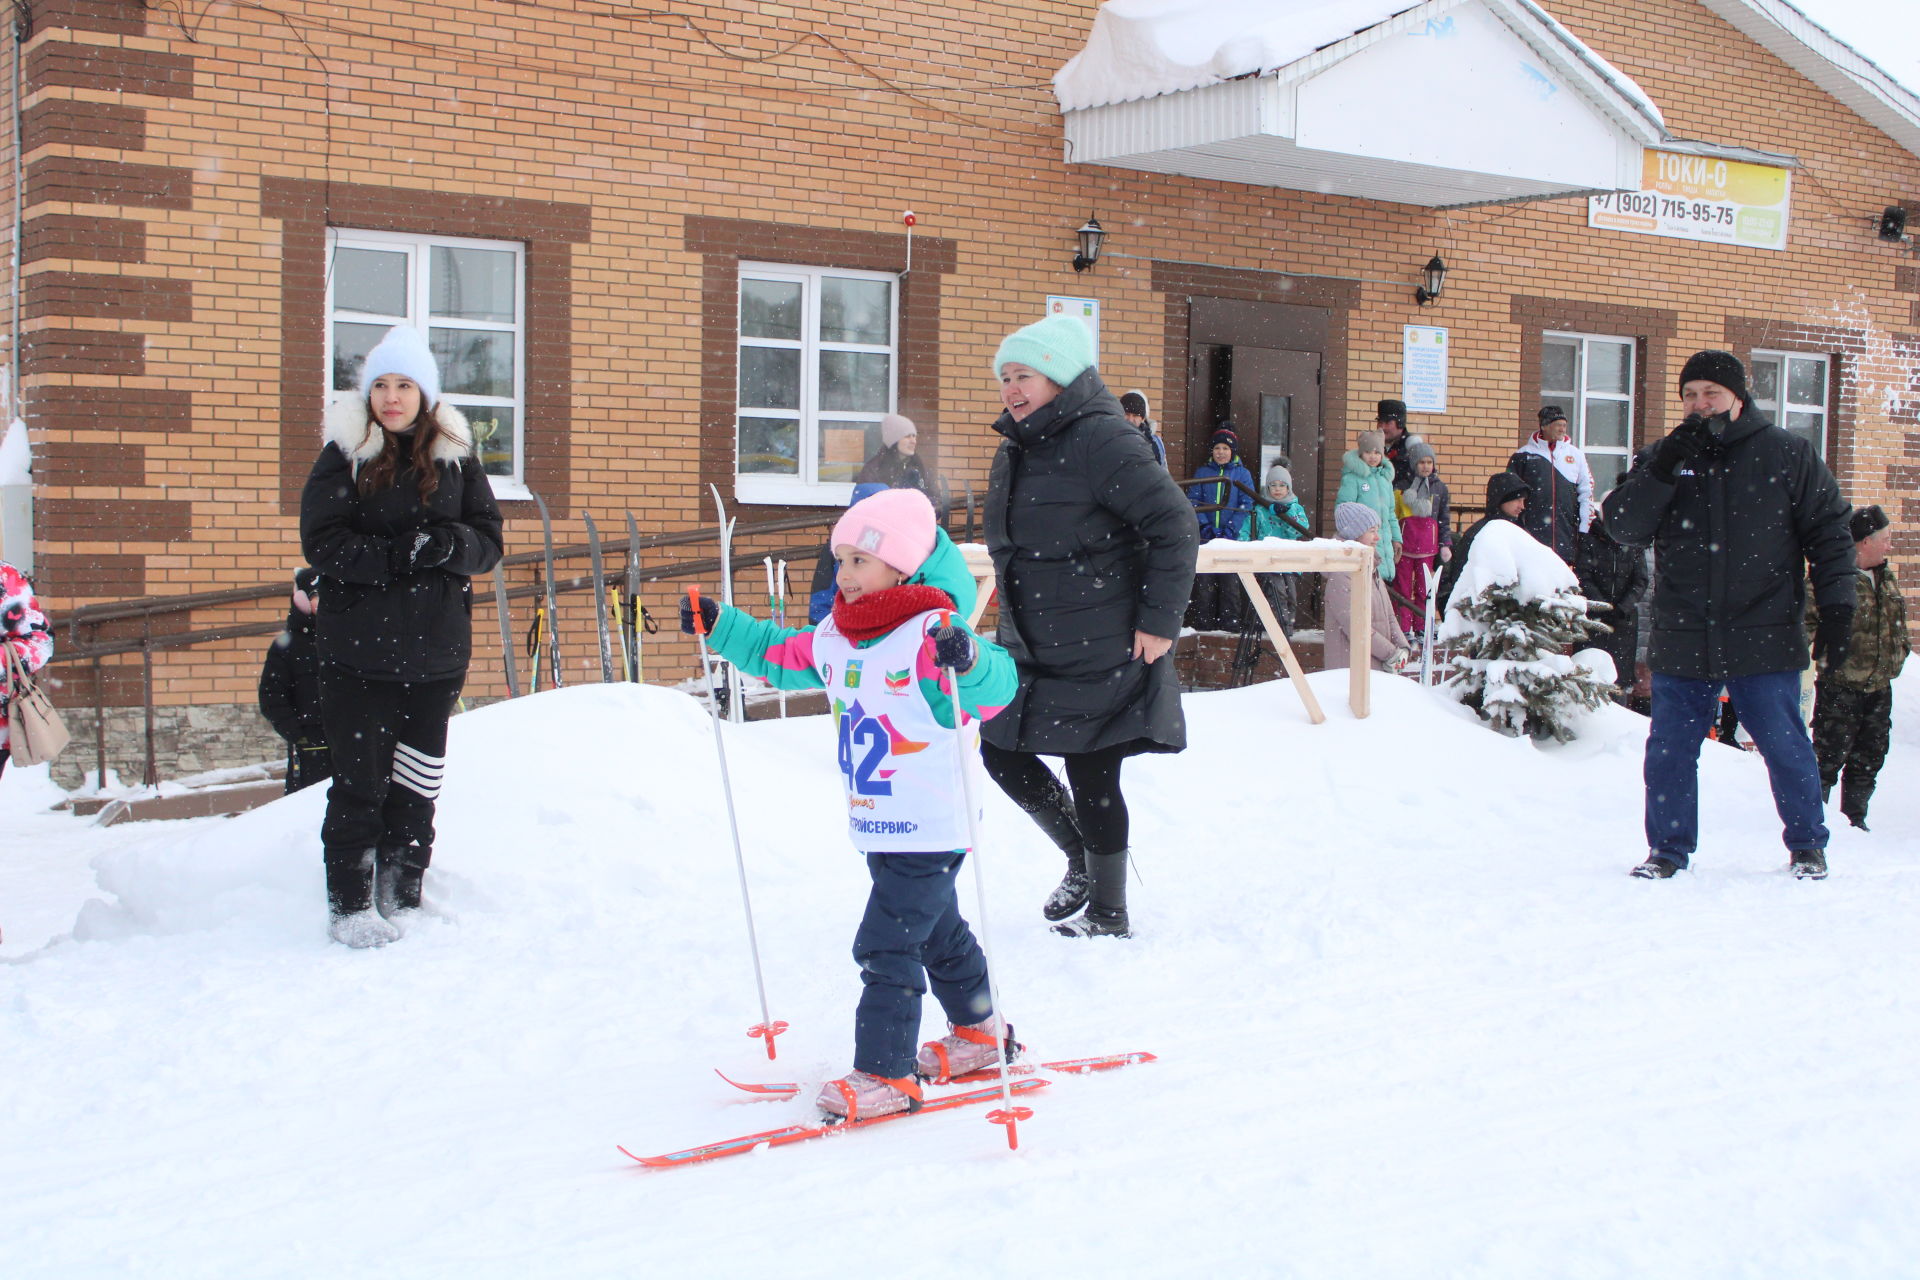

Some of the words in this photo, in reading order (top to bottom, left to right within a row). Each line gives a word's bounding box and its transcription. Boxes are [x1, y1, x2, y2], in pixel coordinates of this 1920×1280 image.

[1656, 152, 1727, 189] ТОКИ-О
[1616, 191, 1657, 217] (902)
[1661, 198, 1734, 225] 715-95-75
[838, 714, 893, 797] 42
